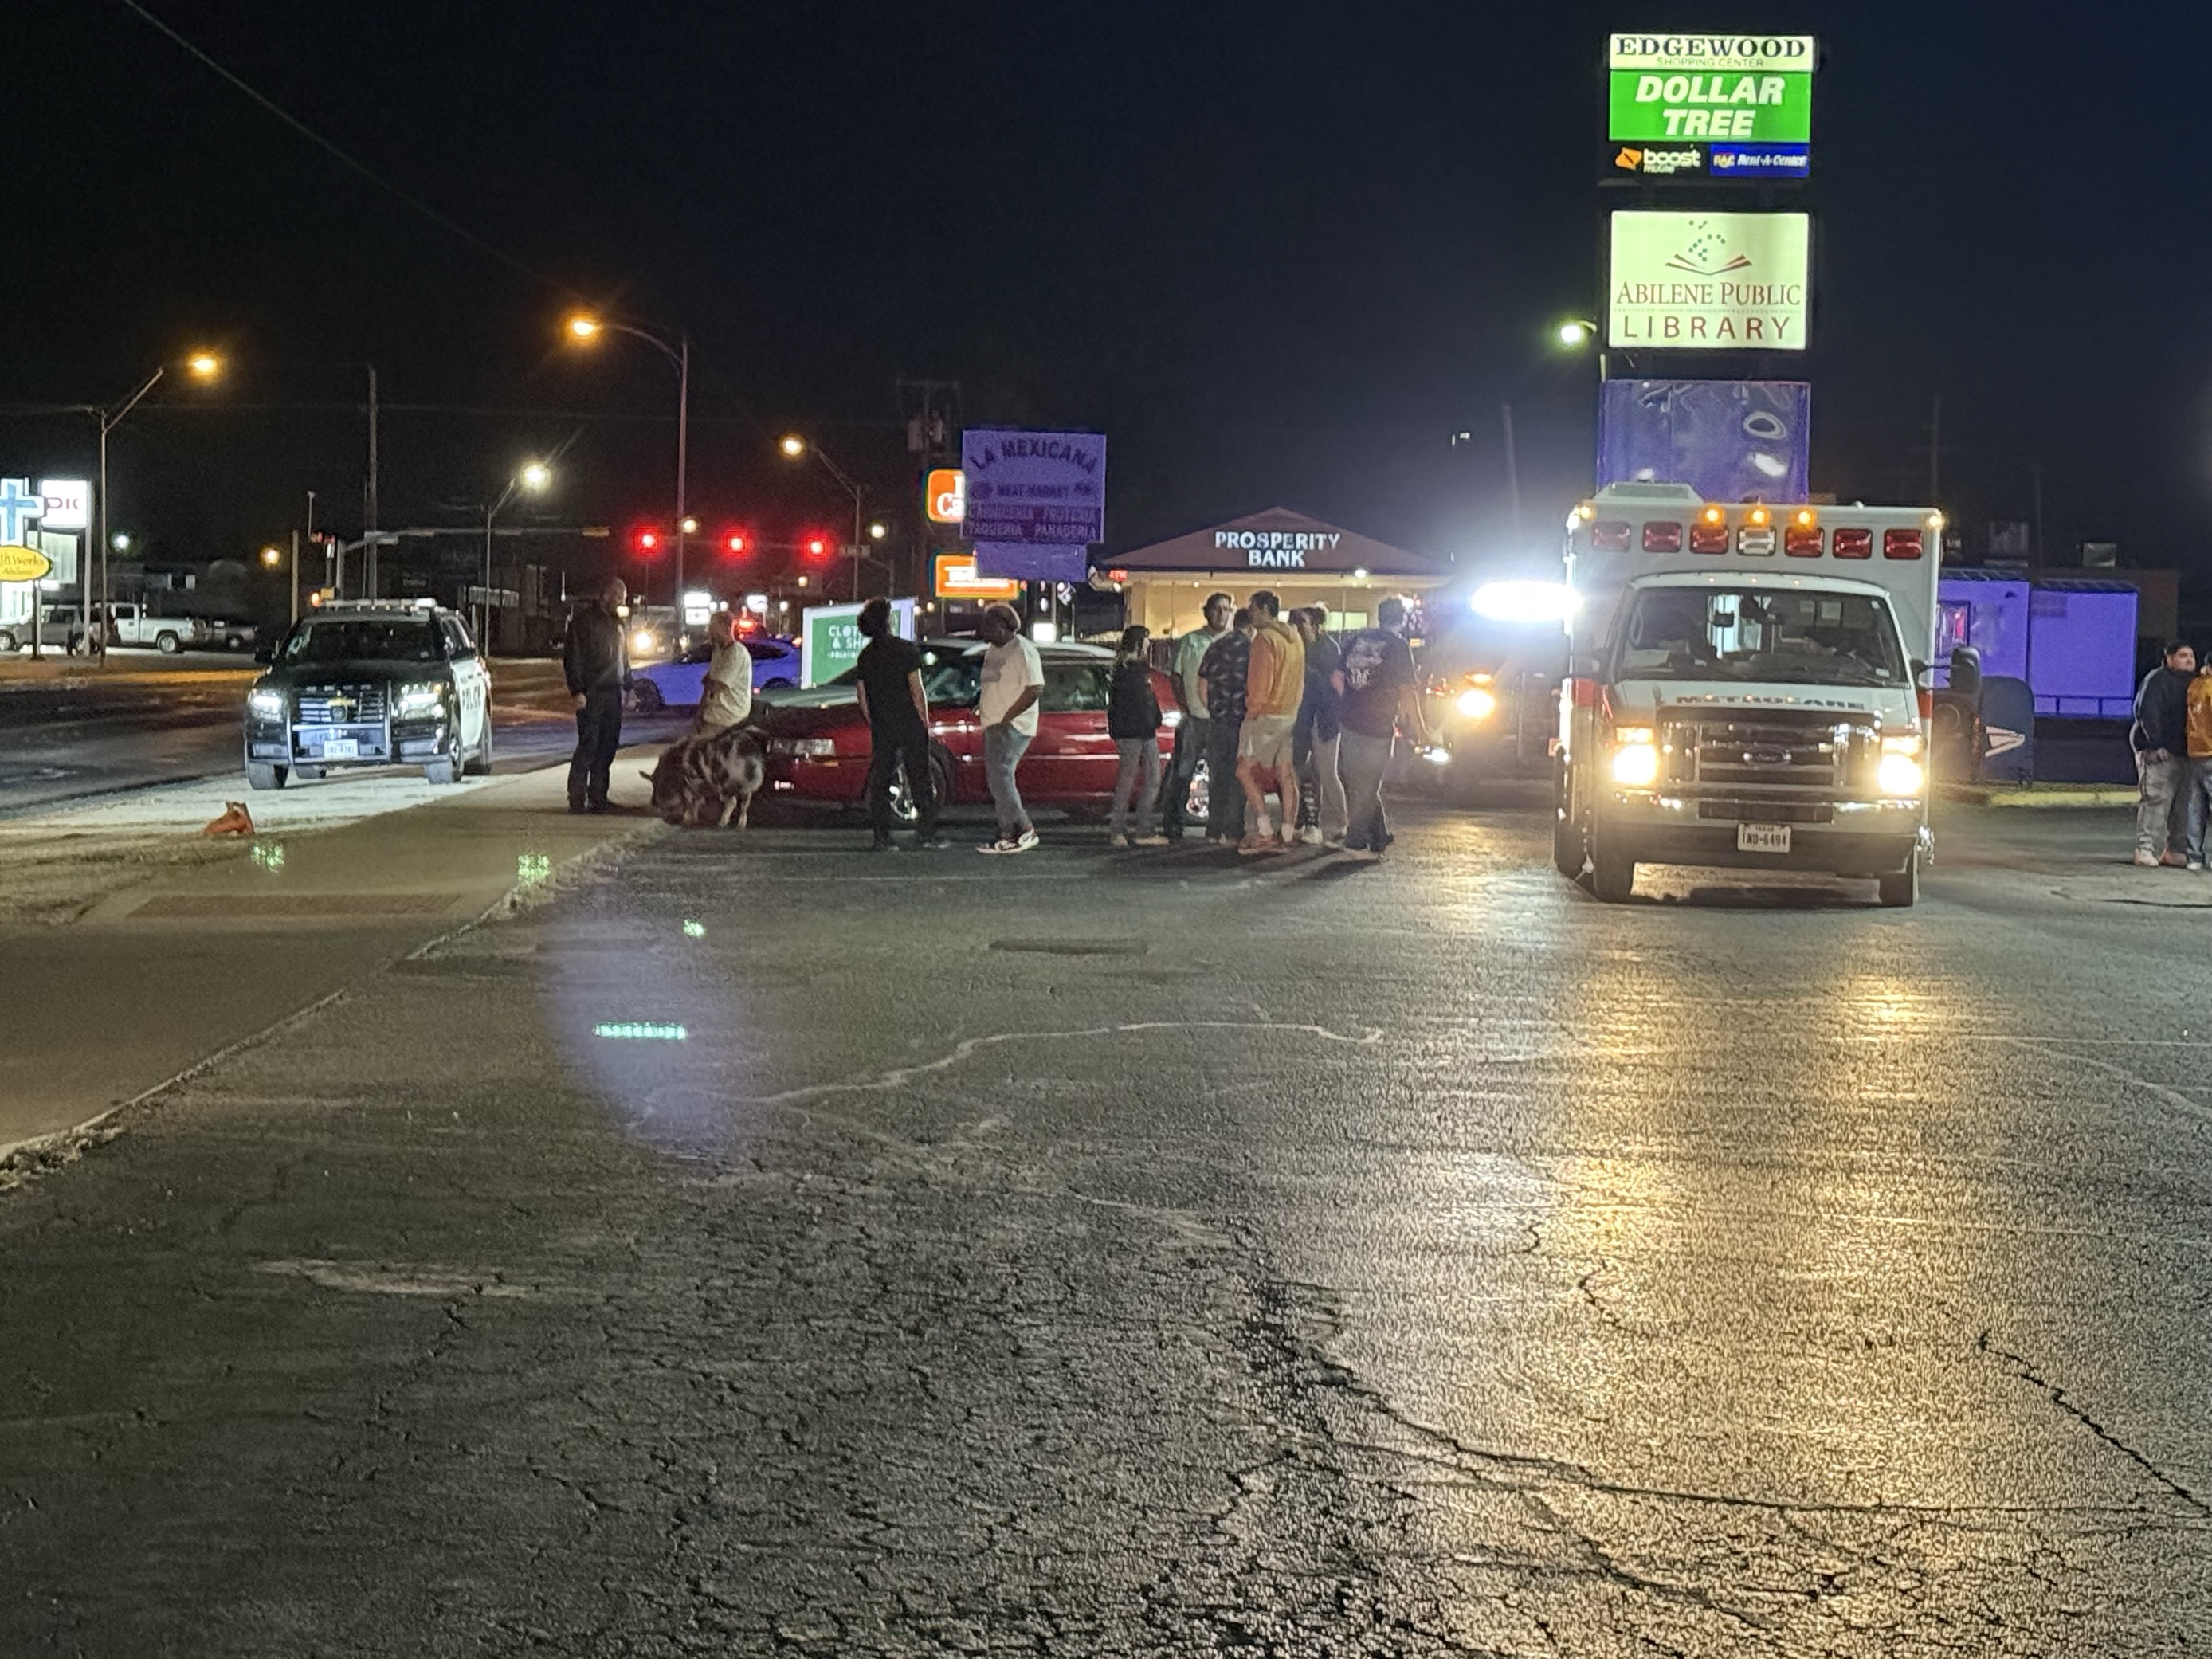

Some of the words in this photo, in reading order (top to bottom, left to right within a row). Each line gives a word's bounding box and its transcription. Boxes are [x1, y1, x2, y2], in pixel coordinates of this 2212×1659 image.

[1615, 37, 1806, 58] EDGEWOOD
[1657, 57, 1715, 67] SHOPPING
[1718, 58, 1764, 68] CENTER
[1635, 76, 1786, 105] DOLLAR
[1663, 109, 1756, 138] TREE
[1643, 148, 1701, 167] boost
[1616, 280, 1714, 305] ABILENE
[1720, 281, 1801, 307] PUBLIC
[1623, 315, 1790, 340] LIBRARY
[969, 448, 996, 470] LA
[1000, 438, 1098, 473] MEXICANA
[1214, 531, 1341, 551] PROSPERITY
[1248, 549, 1306, 567] BANK
